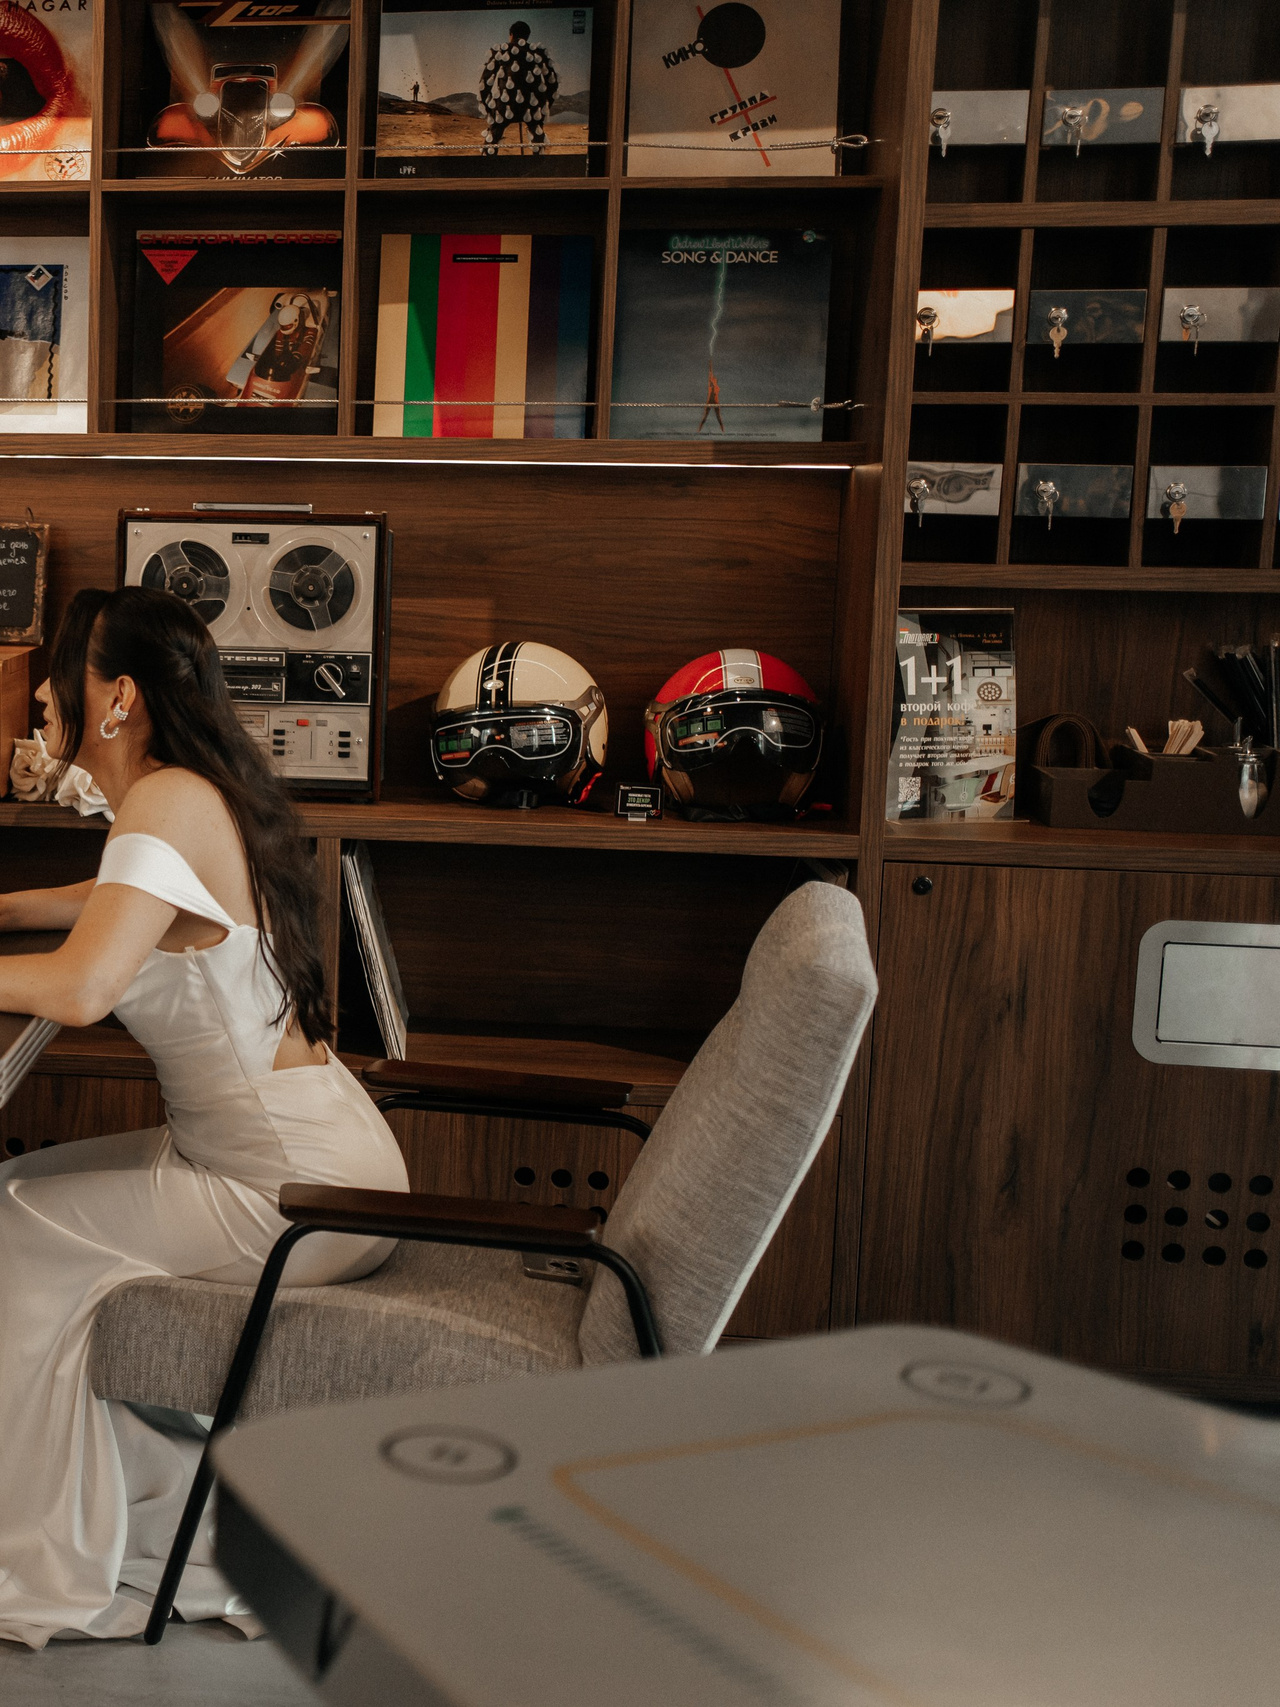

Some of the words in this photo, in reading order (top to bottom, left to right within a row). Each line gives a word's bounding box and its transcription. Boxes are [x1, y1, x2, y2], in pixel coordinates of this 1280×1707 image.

[8, 0, 87, 14] HAGAR
[247, 5, 299, 17] TOP
[662, 39, 706, 69] КИНО
[709, 90, 770, 124] ГРУППА
[139, 234, 268, 245] CHRISTOPHER
[273, 234, 338, 245] CROSS
[661, 250, 707, 264] SONG
[710, 250, 723, 264] &
[726, 250, 779, 264] DANCE
[900, 655, 962, 695] 1+1
[900, 701, 941, 715] второй
[900, 718, 907, 726] в
[913, 714, 966, 729] подарок!
